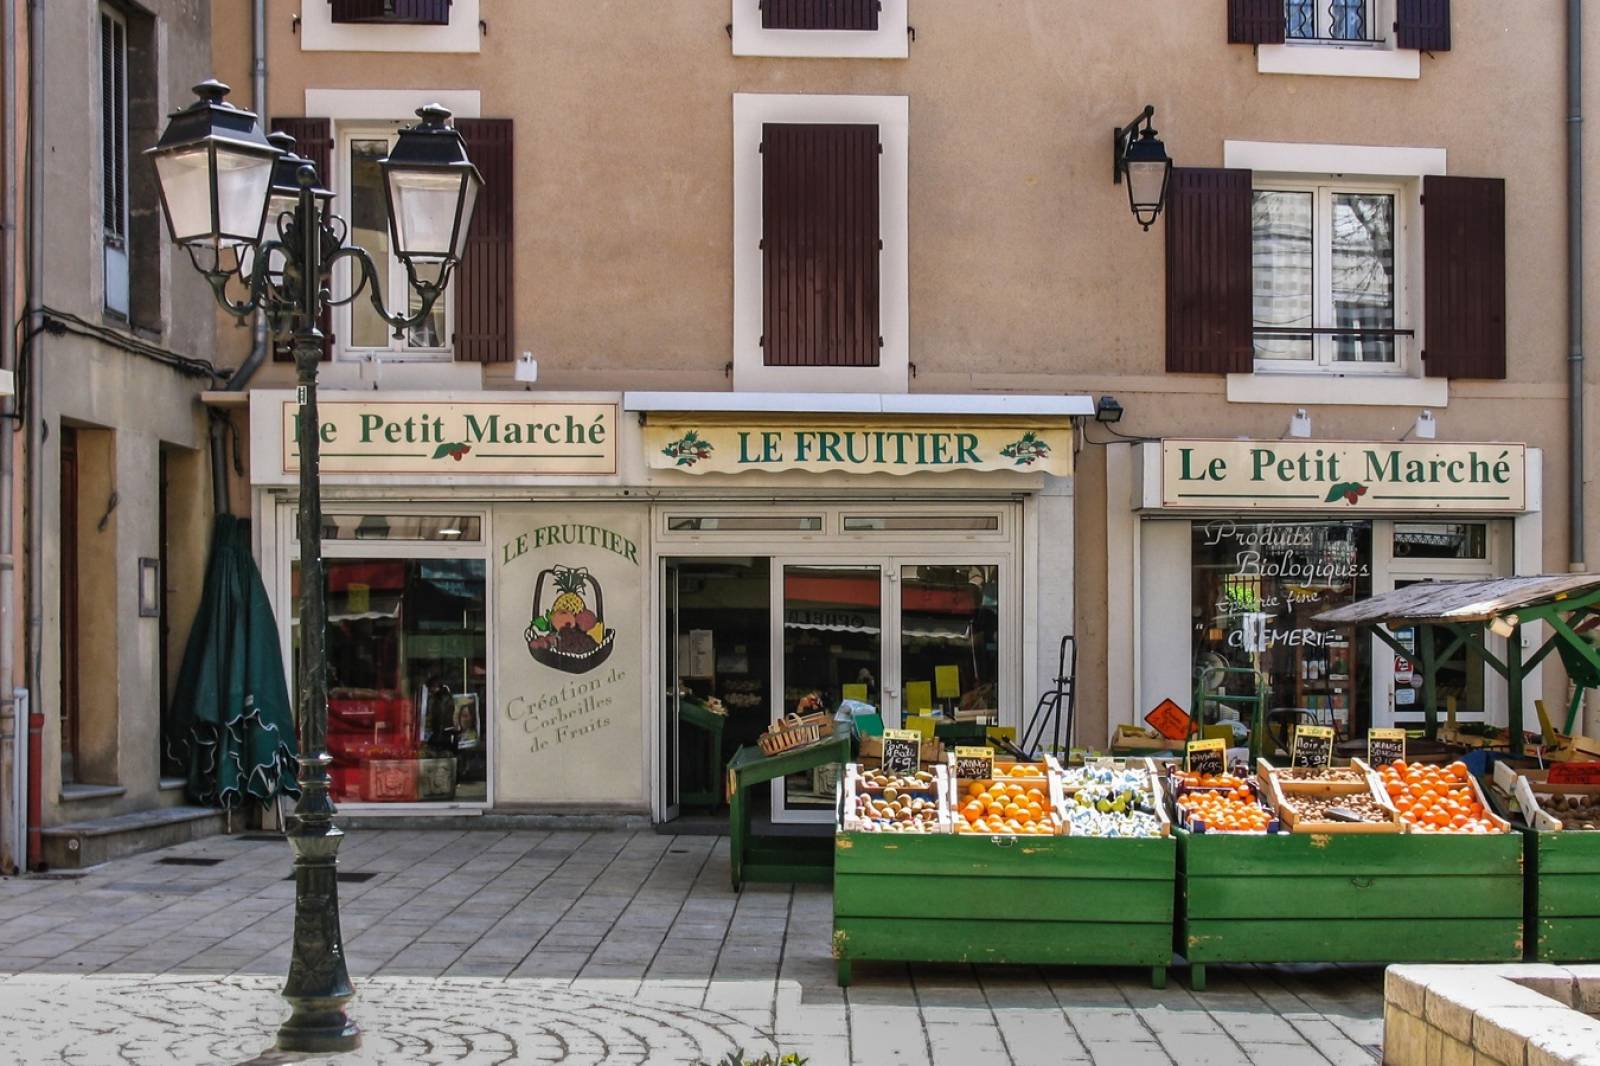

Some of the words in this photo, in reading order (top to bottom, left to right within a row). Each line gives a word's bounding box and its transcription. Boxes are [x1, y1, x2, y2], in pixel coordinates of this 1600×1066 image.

[359, 413, 445, 443] Petit
[463, 413, 606, 444] Marché
[736, 430, 783, 463] LE
[793, 430, 984, 465] FRUITIER
[1178, 447, 1227, 482] Le
[1249, 447, 1341, 483] Petit
[1363, 450, 1511, 484] Marché
[503, 533, 529, 566] LE
[533, 523, 640, 566] FRUITIER
[1203, 519, 1313, 546] Produits
[1228, 549, 1371, 588] Biologiques
[504, 676, 602, 722] Création
[607, 668, 627, 684] de
[523, 693, 614, 735] Corbeilles
[530, 736, 549, 754] de
[555, 716, 612, 744] Fruits
